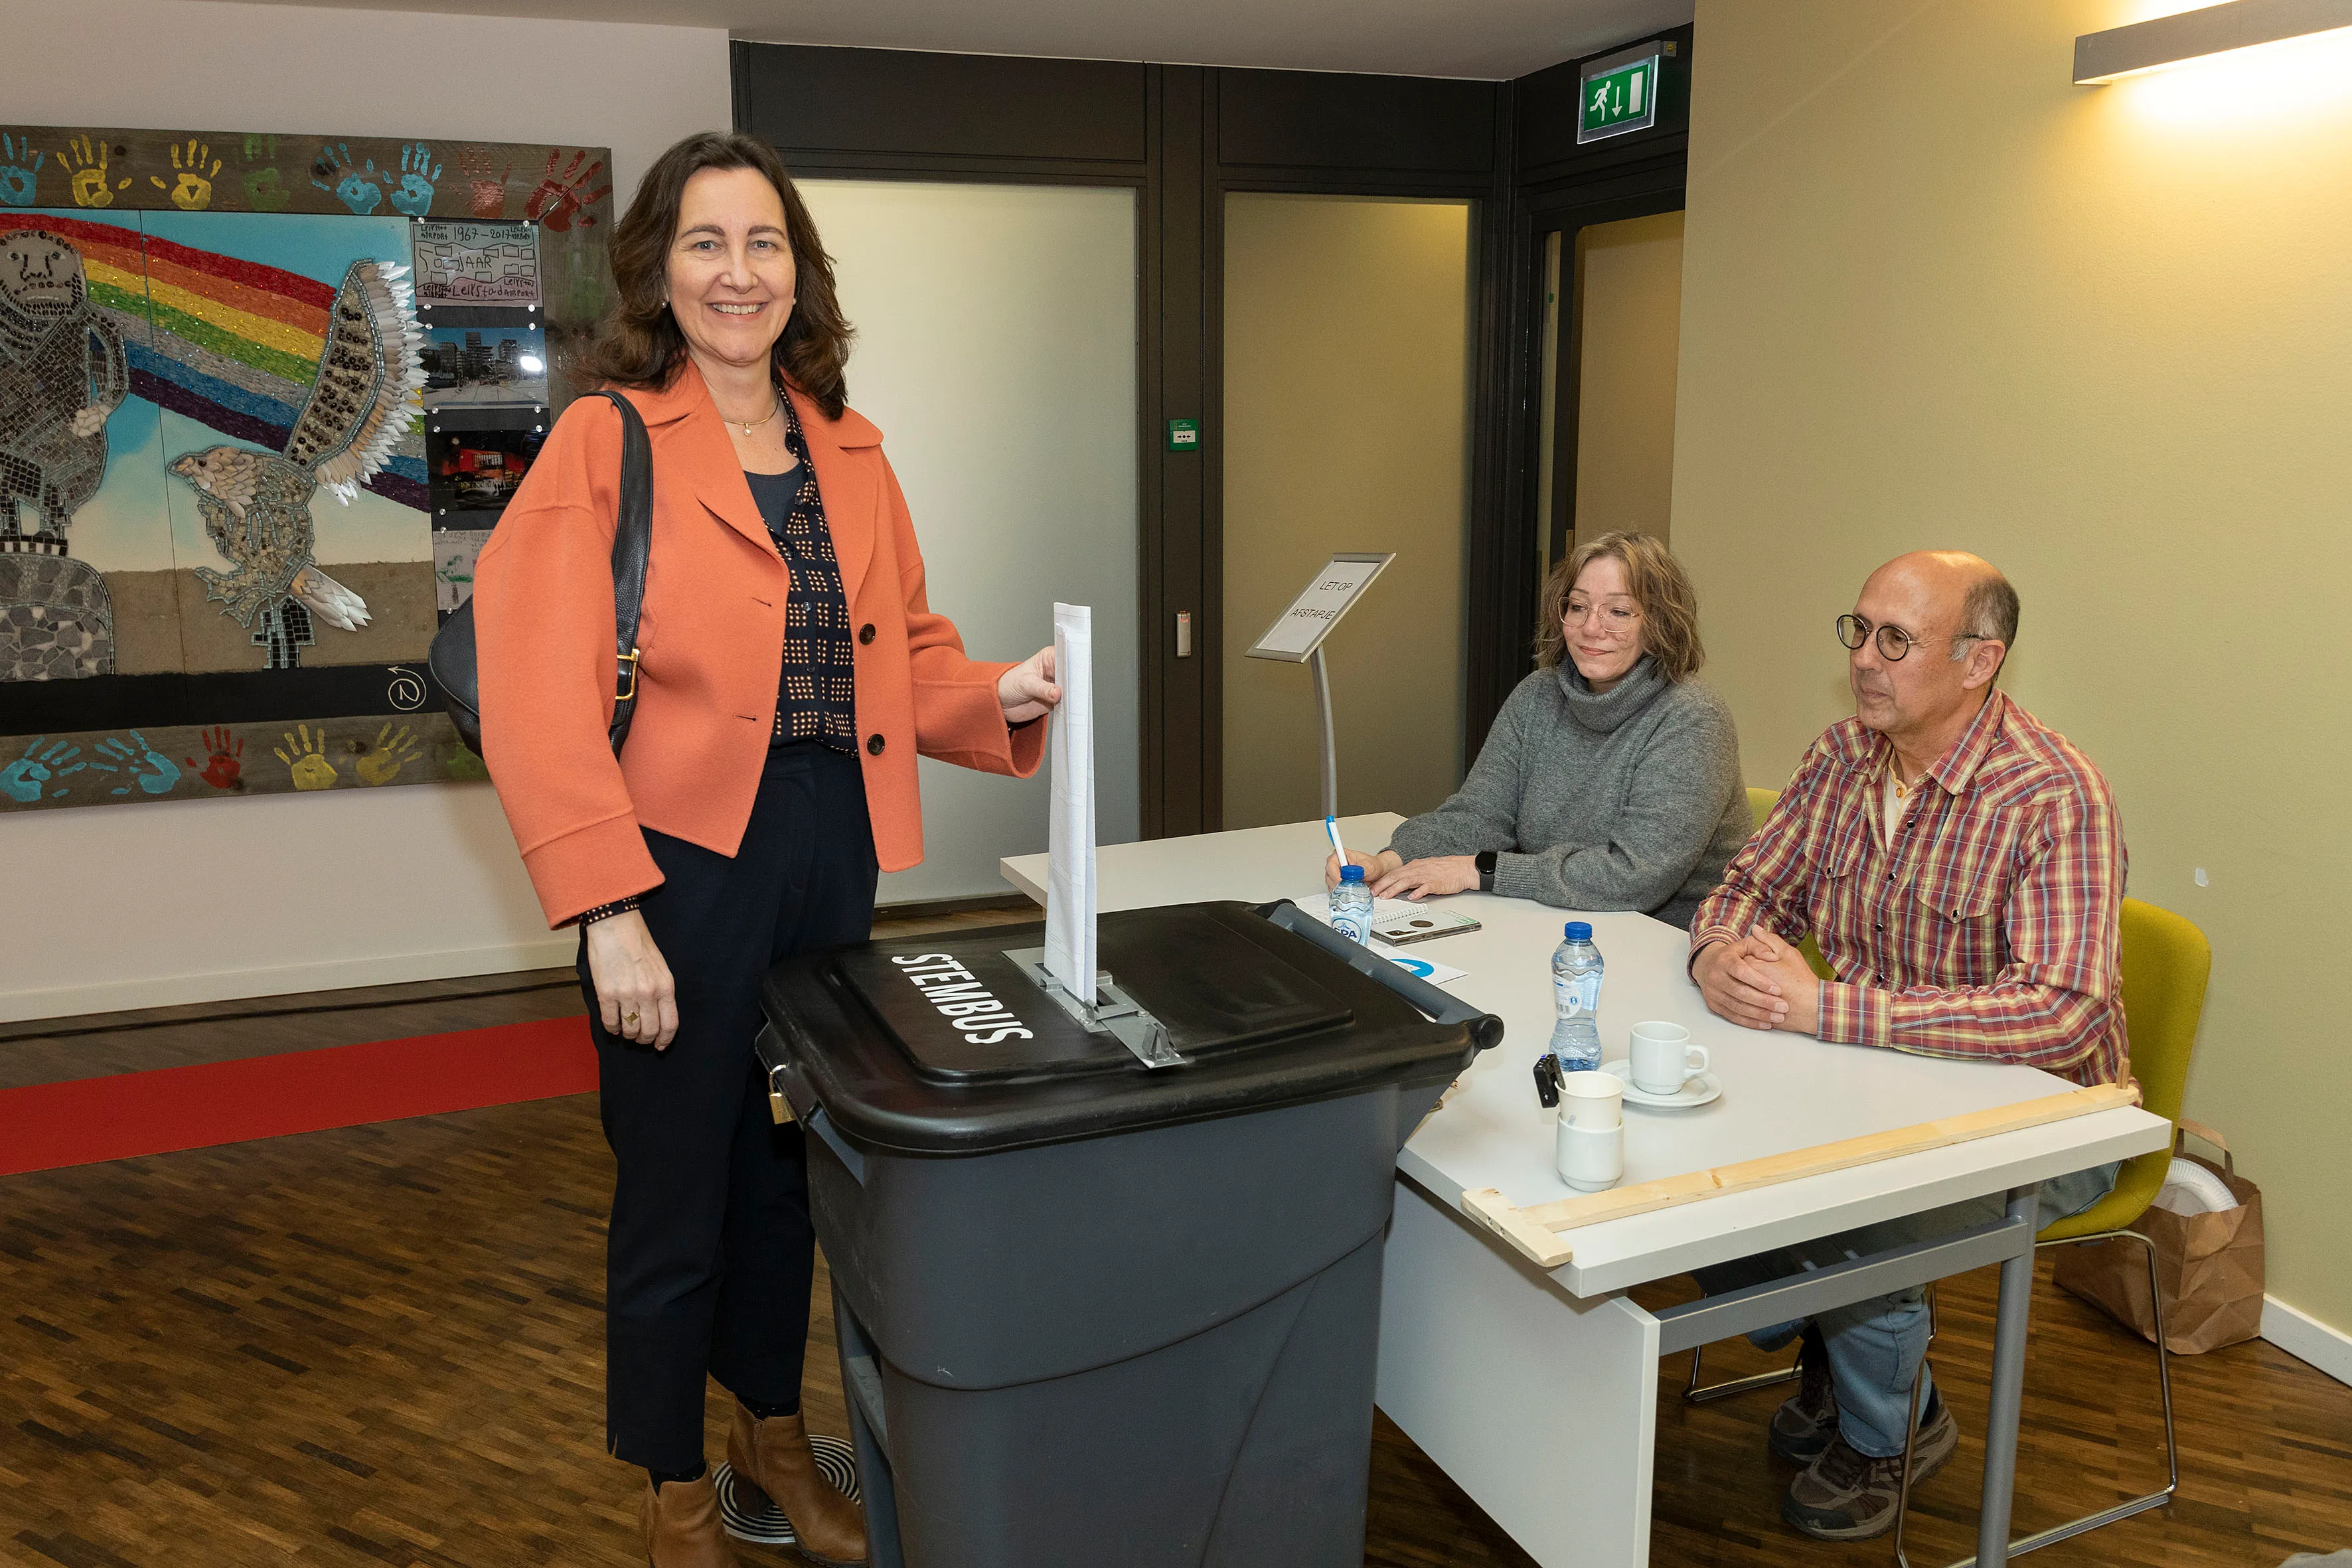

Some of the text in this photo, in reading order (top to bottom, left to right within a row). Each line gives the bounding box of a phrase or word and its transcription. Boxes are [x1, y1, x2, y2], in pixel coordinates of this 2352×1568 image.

[454, 226, 479, 241] 1967
[490, 229, 510, 239] 2017
[1319, 581, 1353, 591] LET OP
[1291, 608, 1336, 619] AFSTAPJE
[892, 953, 1034, 1044] STEMBUS
